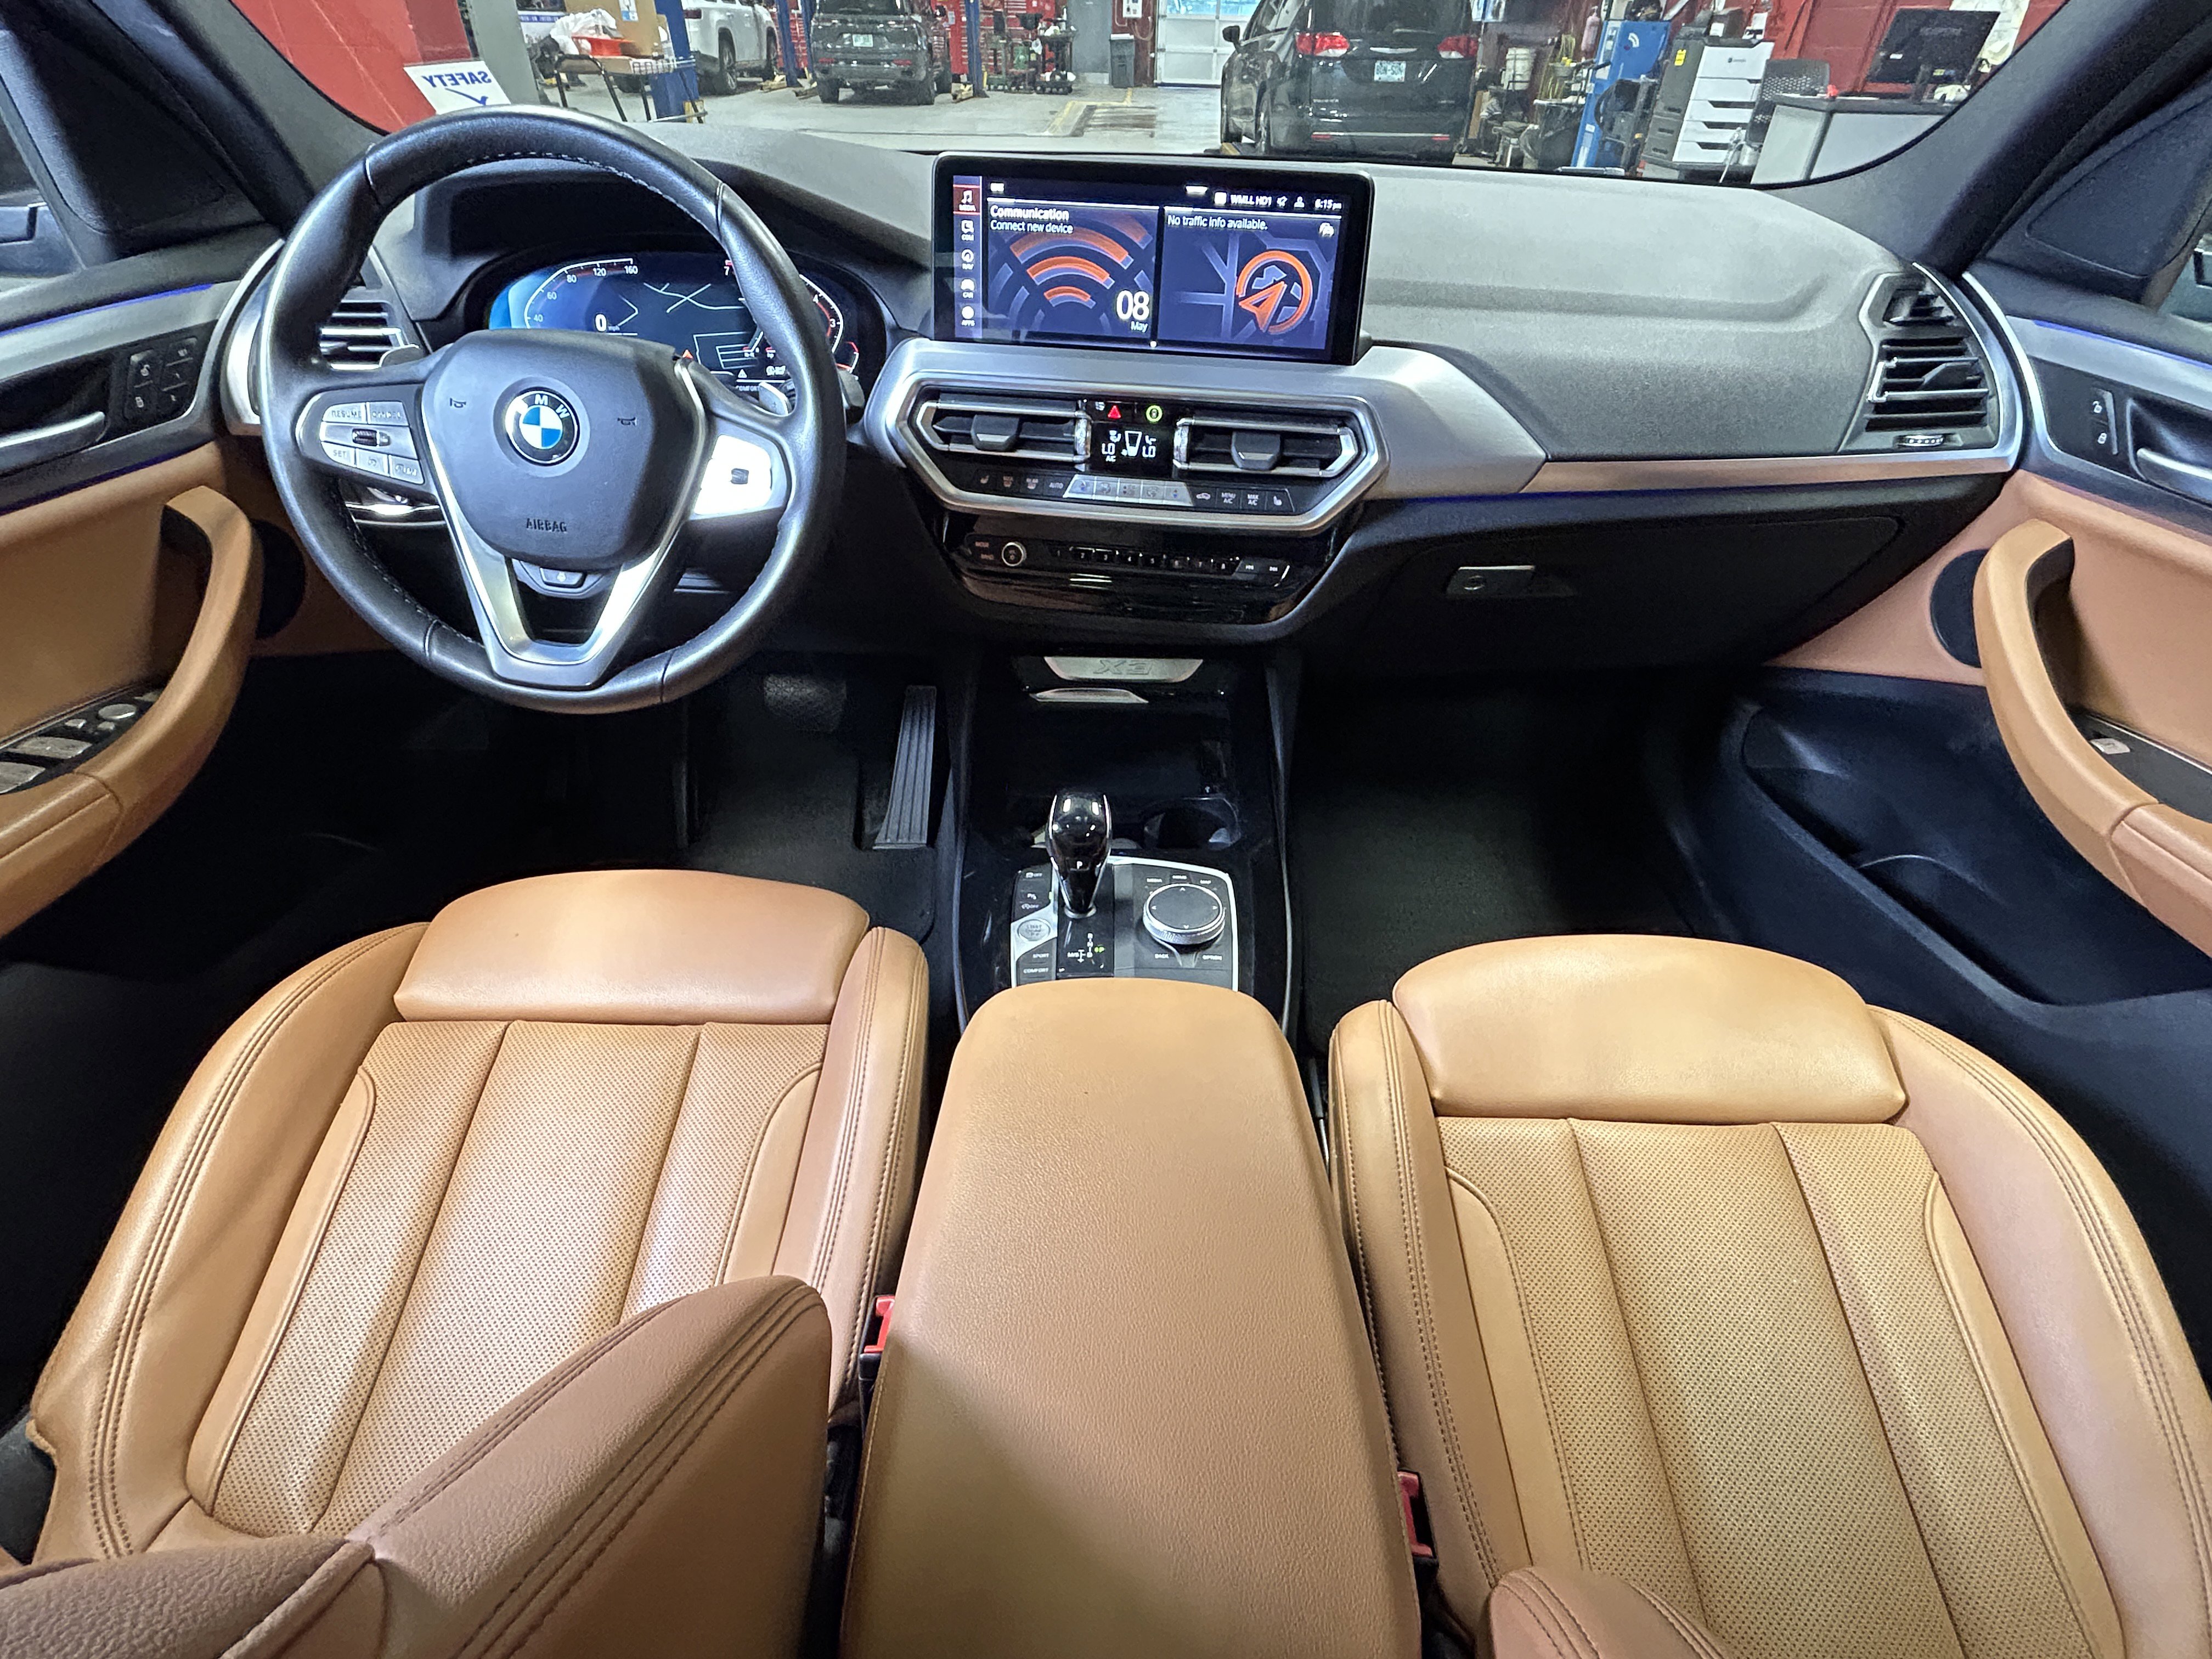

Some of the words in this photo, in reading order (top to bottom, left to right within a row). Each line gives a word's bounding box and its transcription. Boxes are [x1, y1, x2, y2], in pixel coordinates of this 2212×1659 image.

[1230, 194, 1255, 205] WMLL
[1255, 195, 1272, 206] HD1
[990, 205, 1070, 221] Communication
[990, 219, 1025, 232] Connect
[1027, 222, 1044, 233] new
[1045, 223, 1074, 234] device
[1167, 215, 1180, 225] No
[1182, 216, 1207, 227] traffic
[1209, 217, 1226, 228] info
[1227, 218, 1268, 230] available.
[593, 267, 607, 276] 120
[624, 266, 638, 274] 160
[724, 266, 730, 275] 7
[566, 275, 577, 284] 80
[548, 291, 557, 301] 60
[812, 294, 819, 303] 4
[1116, 290, 1149, 320] 08
[534, 314, 544, 323] 40
[595, 314, 607, 331] 0
[830, 318, 836, 328] 3
[1131, 321, 1148, 333] May
[331, 409, 362, 419] RESUME
[333, 449, 347, 458] SET
[1102, 443, 1115, 455] LO
[1142, 445, 1156, 458] LO
[526, 517, 567, 533] AIRBAG
[1092, 659, 1153, 675] X3
[1076, 860, 1083, 870] P
